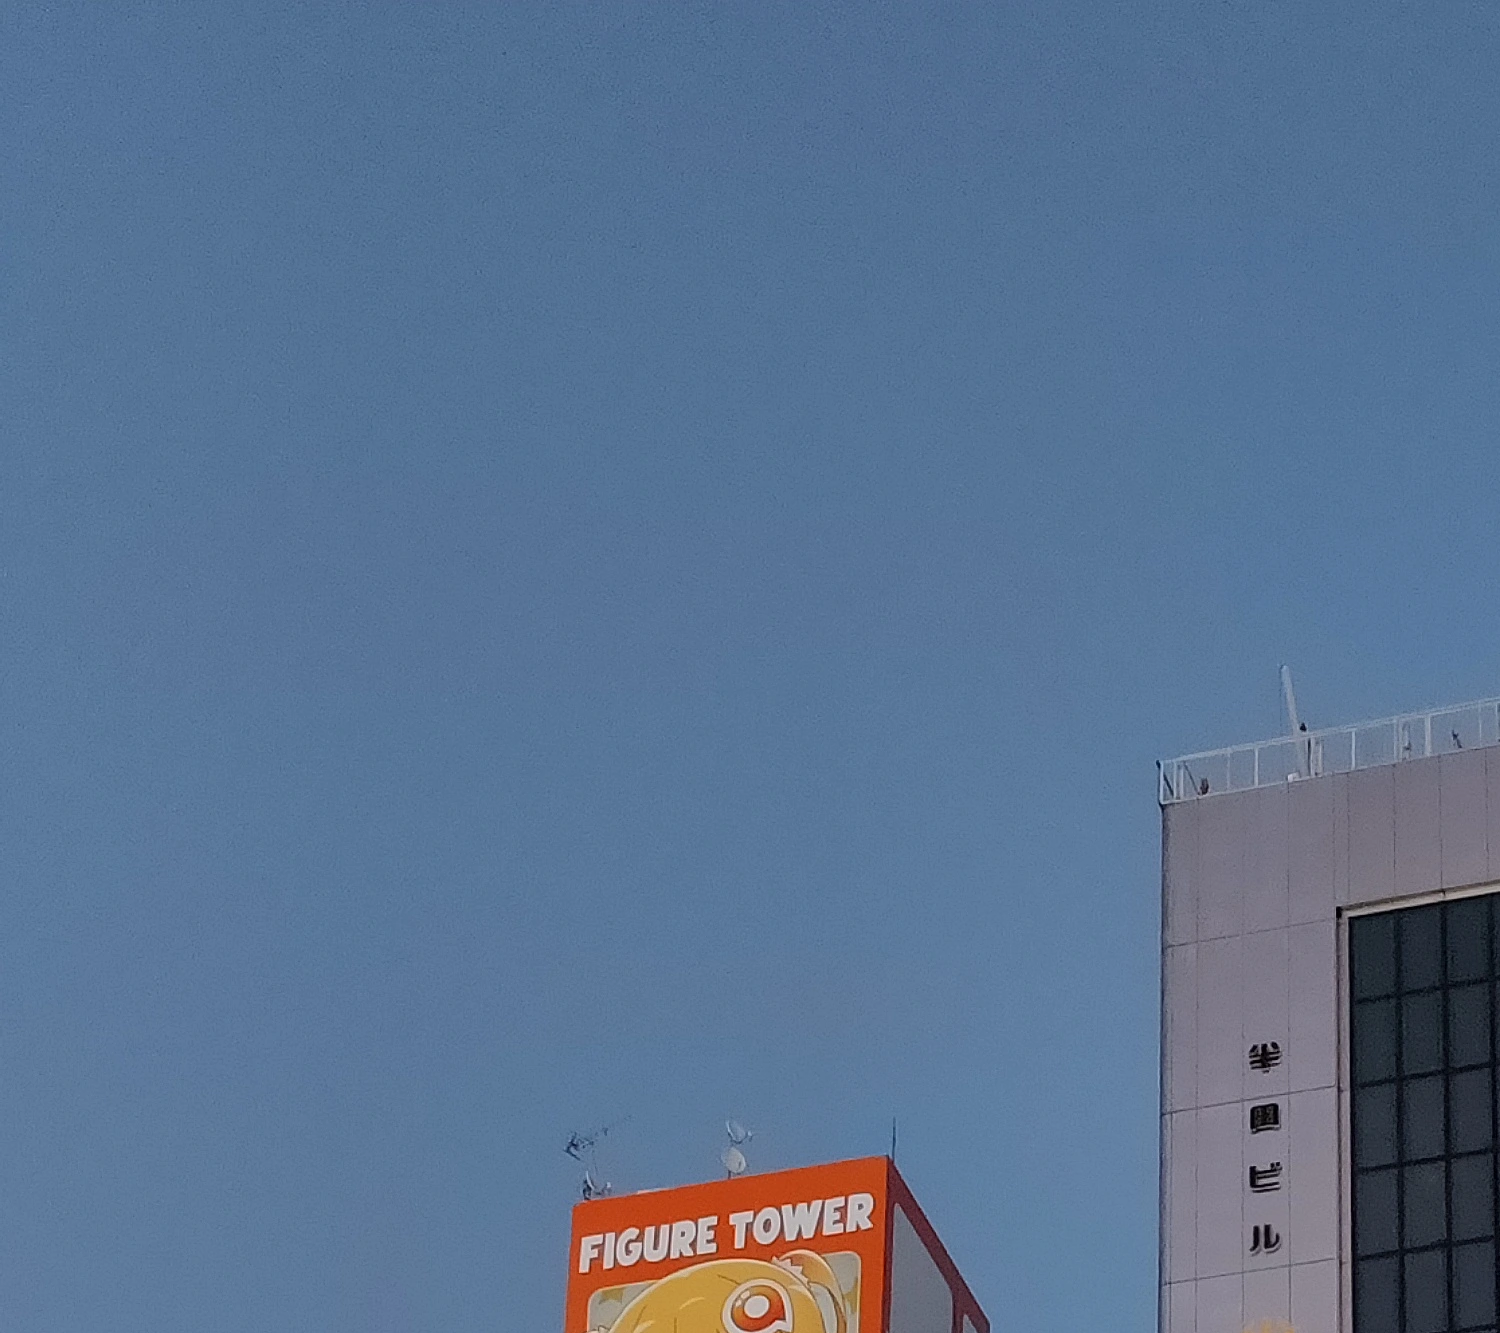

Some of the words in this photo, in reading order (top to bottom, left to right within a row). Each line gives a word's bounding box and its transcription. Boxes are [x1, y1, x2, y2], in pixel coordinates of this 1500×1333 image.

[1248, 1041, 1283, 1256] 半田ビル
[579, 1215, 719, 1274] FIGURE
[728, 1192, 875, 1251] TOWER
